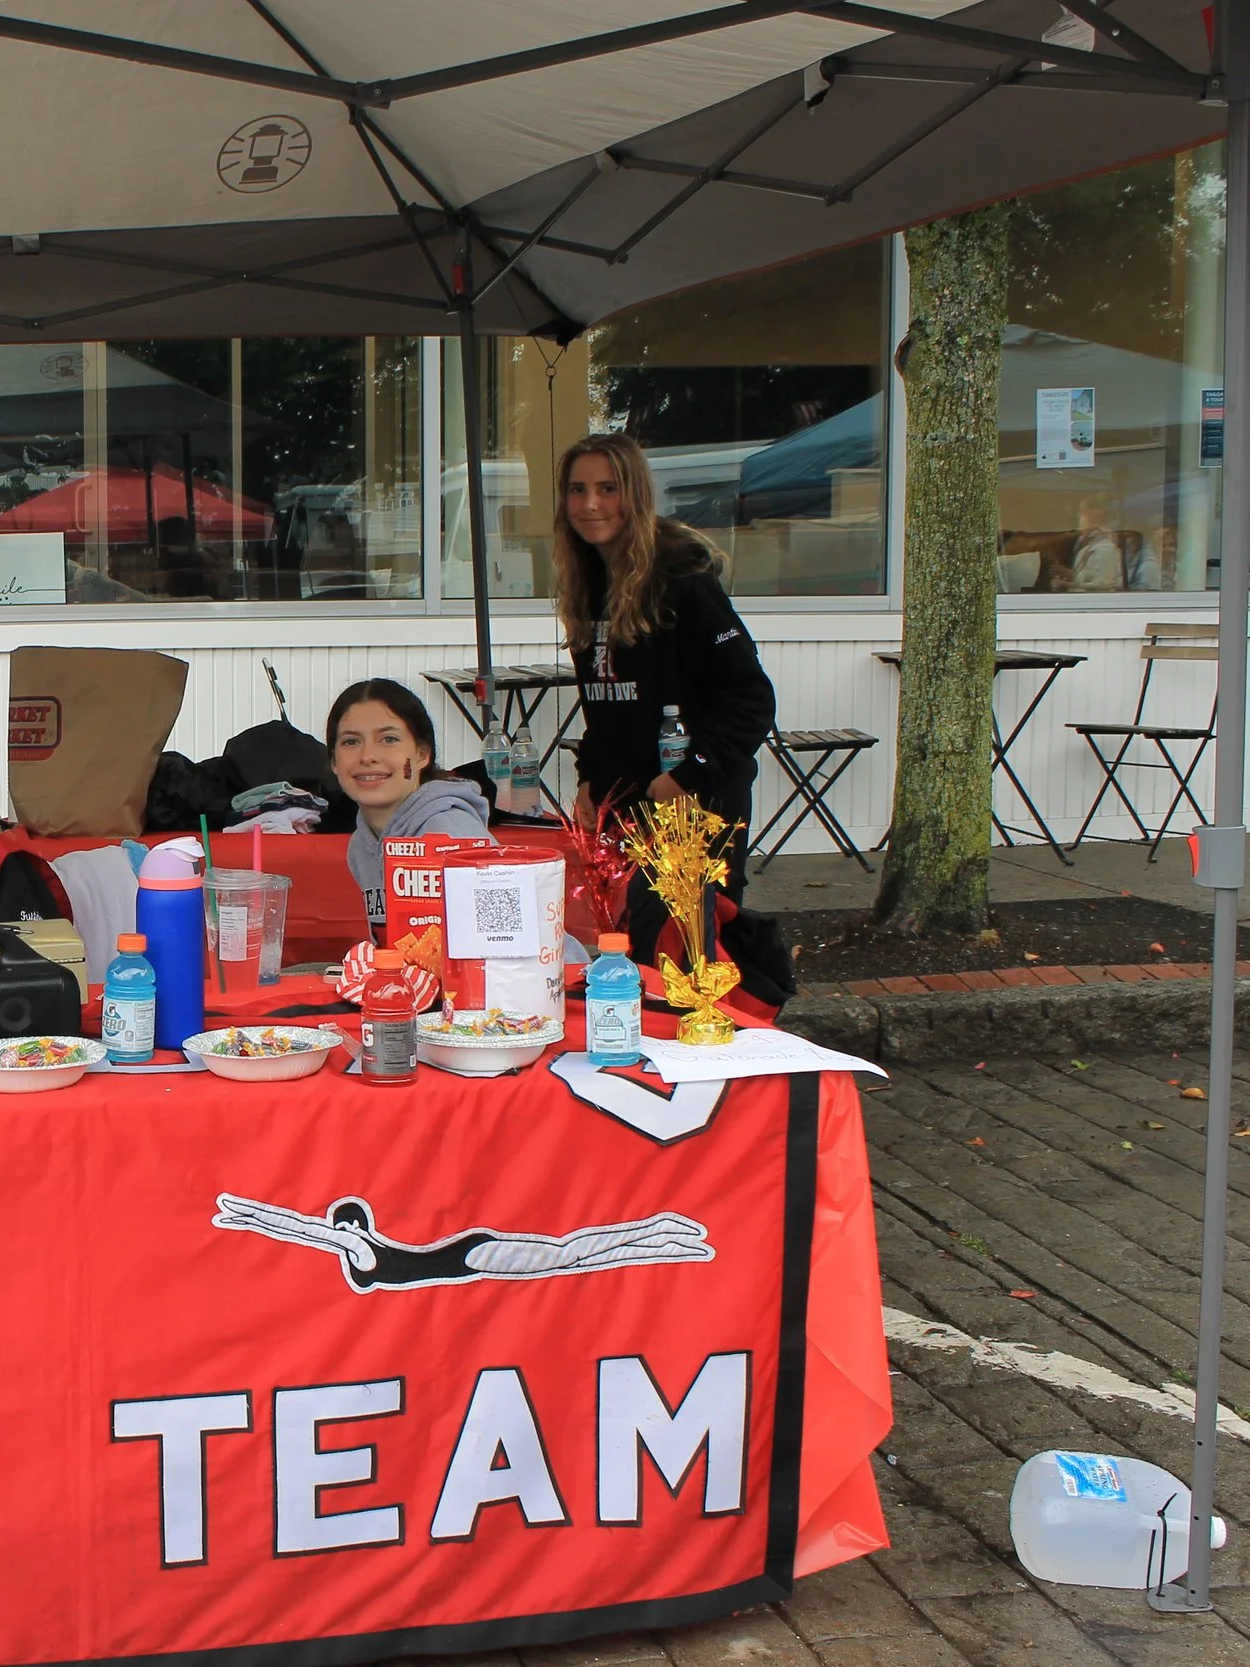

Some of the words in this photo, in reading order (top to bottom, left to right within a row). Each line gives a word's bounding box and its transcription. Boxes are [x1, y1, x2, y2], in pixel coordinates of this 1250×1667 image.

[392, 867, 442, 898] CHEE
[107, 1002, 116, 1017] G
[603, 1005, 615, 1017] G
[597, 1017, 620, 1025] ZERO
[361, 1023, 374, 1047] G
[111, 1350, 752, 1569] TEAM
